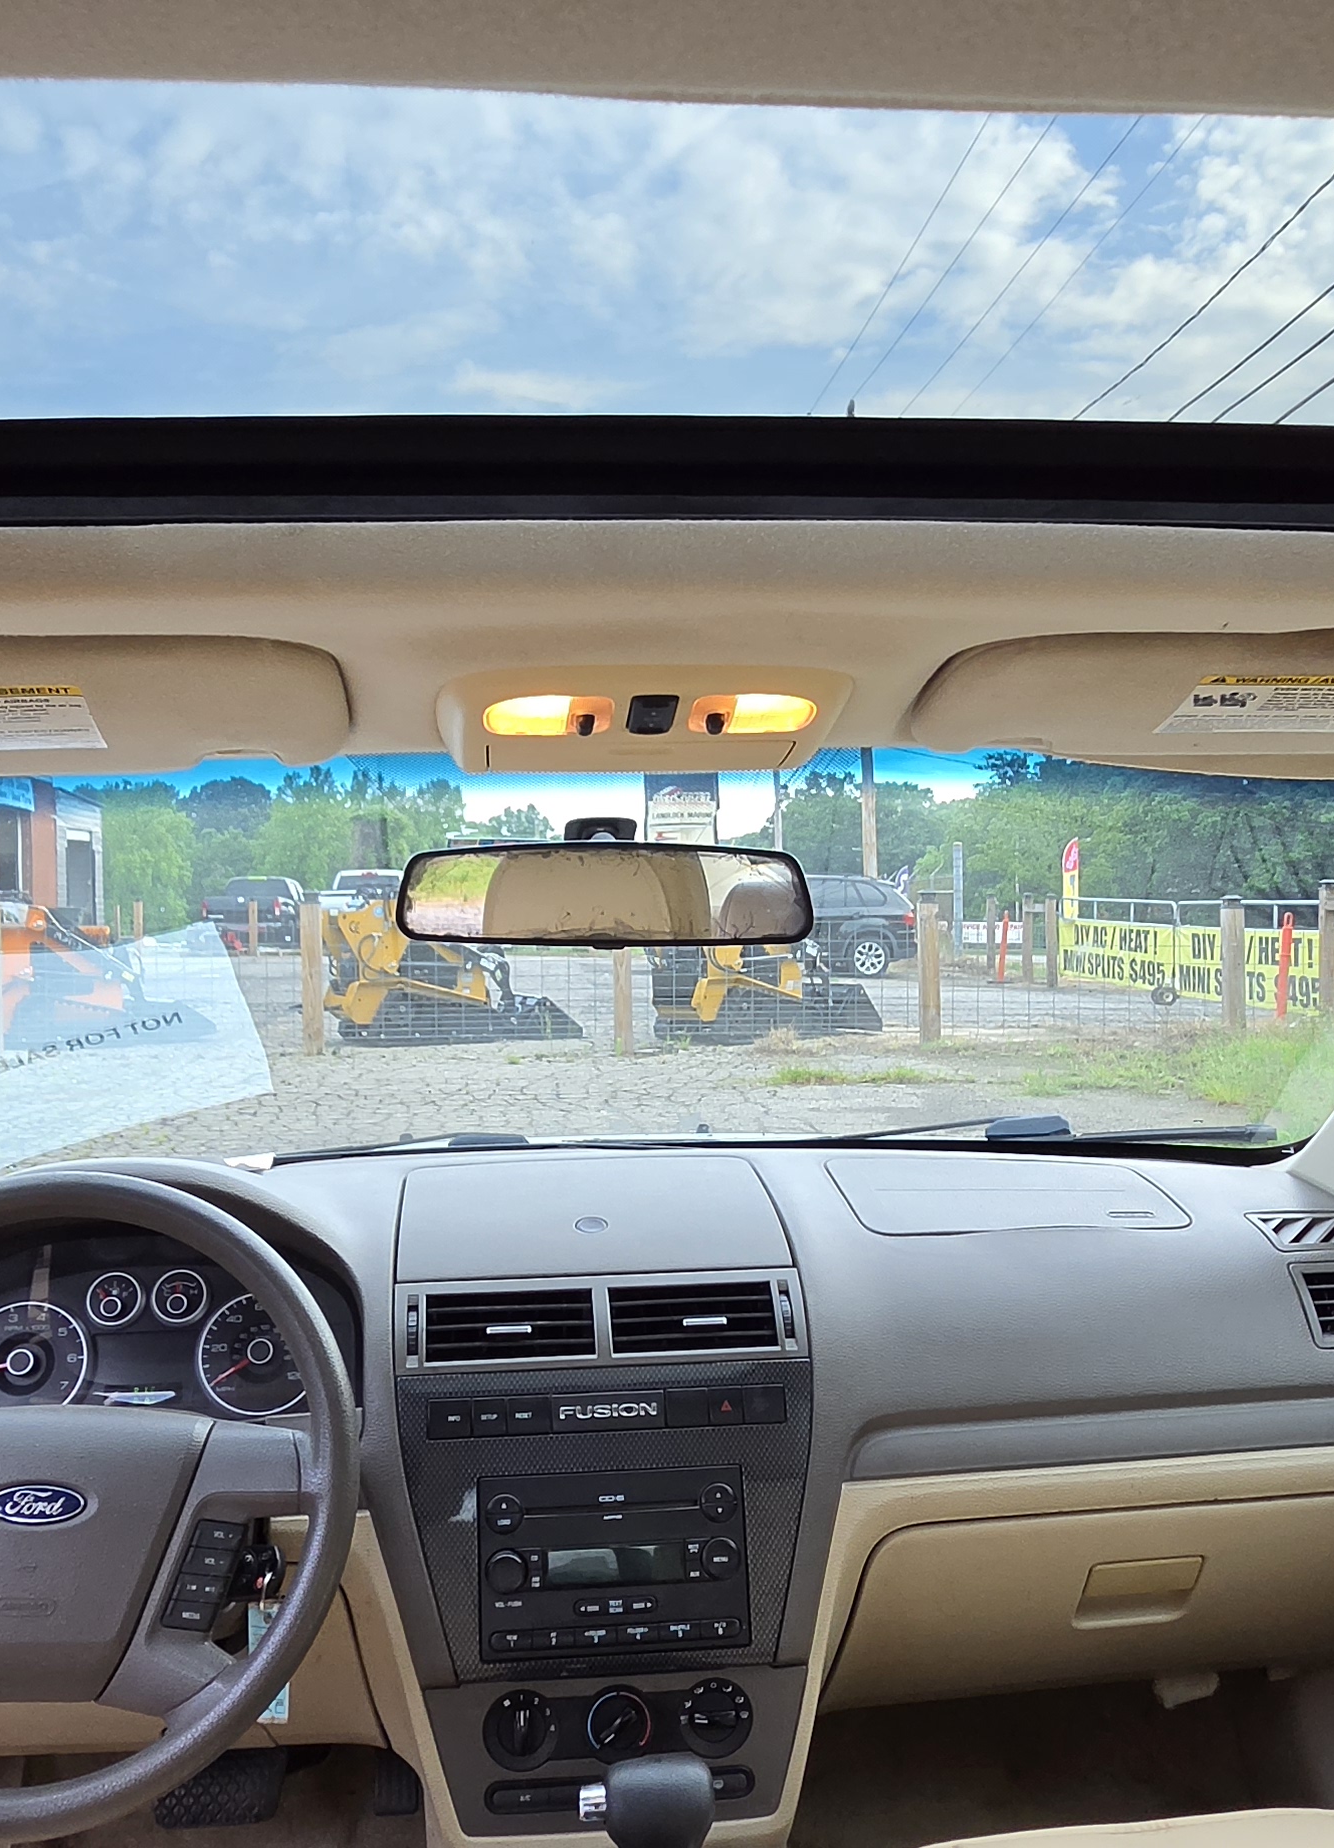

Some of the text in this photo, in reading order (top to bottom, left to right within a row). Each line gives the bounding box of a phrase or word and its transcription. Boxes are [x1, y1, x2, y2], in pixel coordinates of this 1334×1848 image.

[1235, 676, 1309, 684] WARNING
[1074, 924, 1091, 946] DIY
[1093, 926, 1108, 949] AC
[1119, 928, 1150, 954] HEAT
[1191, 933, 1217, 961] DIY
[1258, 936, 1303, 968] HET
[1063, 949, 1165, 988] MINI SPLITS $495
[1179, 964, 1211, 994] MINI
[8, 1313, 19, 1323] 3
[36, 1312, 46, 1322] 4
[226, 1314, 243, 1323] 40
[4, 1324, 24, 1332] RPM
[57, 1327, 68, 1337] 5
[210, 1343, 228, 1353] 20
[66, 1353, 78, 1363] 6
[59, 1380, 69, 1390] 7
[558, 1401, 658, 1420] FUSION
[447, 1411, 533, 1423] INFO SETUP RESET
[4, 1489, 66, 1516] Ford
